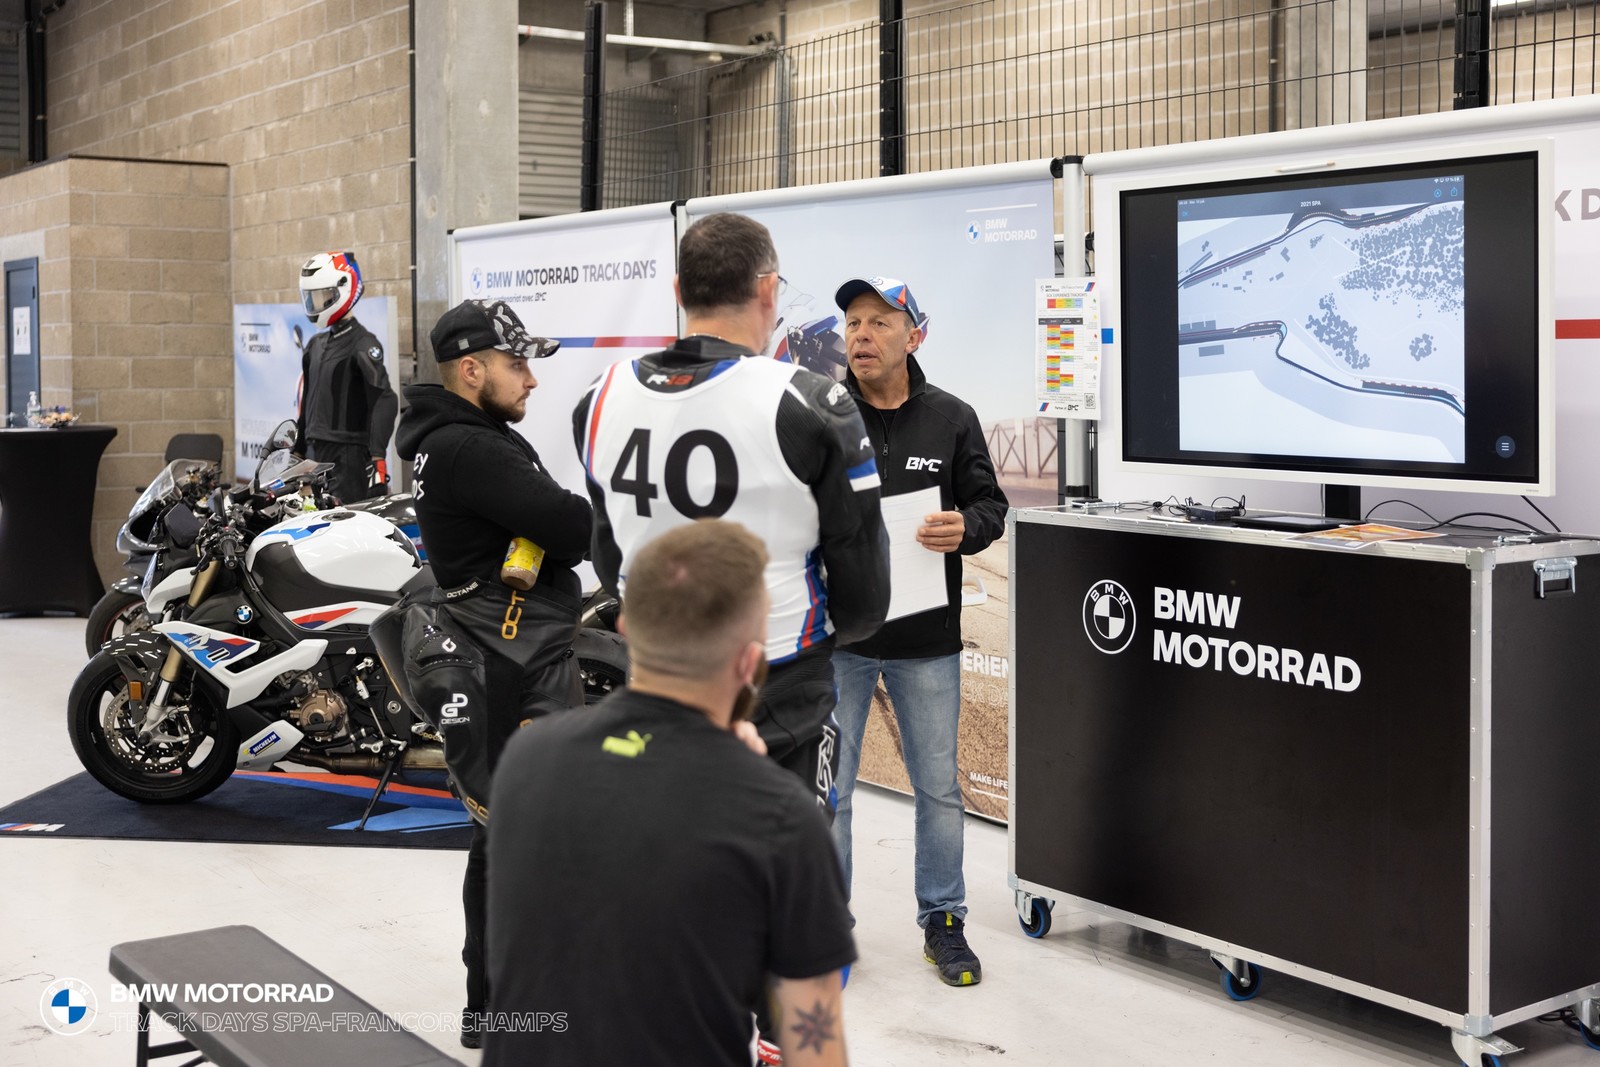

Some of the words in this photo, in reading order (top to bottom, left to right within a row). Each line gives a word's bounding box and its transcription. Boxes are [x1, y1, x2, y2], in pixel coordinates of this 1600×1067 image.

[985, 217, 1008, 230] BMW
[984, 229, 1037, 243] MOTORRAD
[486, 270, 513, 289] BMW
[515, 266, 579, 287] MOTORRAD
[582, 262, 621, 283] TRACK
[622, 259, 657, 281] DAYS
[905, 456, 943, 472] BMC
[610, 428, 740, 521] 40
[446, 581, 479, 598] OCTANE
[1090, 583, 1129, 606] BMW
[1154, 586, 1241, 629] BMW
[1153, 629, 1362, 692] MOTORRAD
[441, 717, 470, 725] DESIGN
[252, 733, 277, 753] MICHELIN
[970, 771, 991, 785] MAKE
[992, 777, 1008, 790] LIFE
